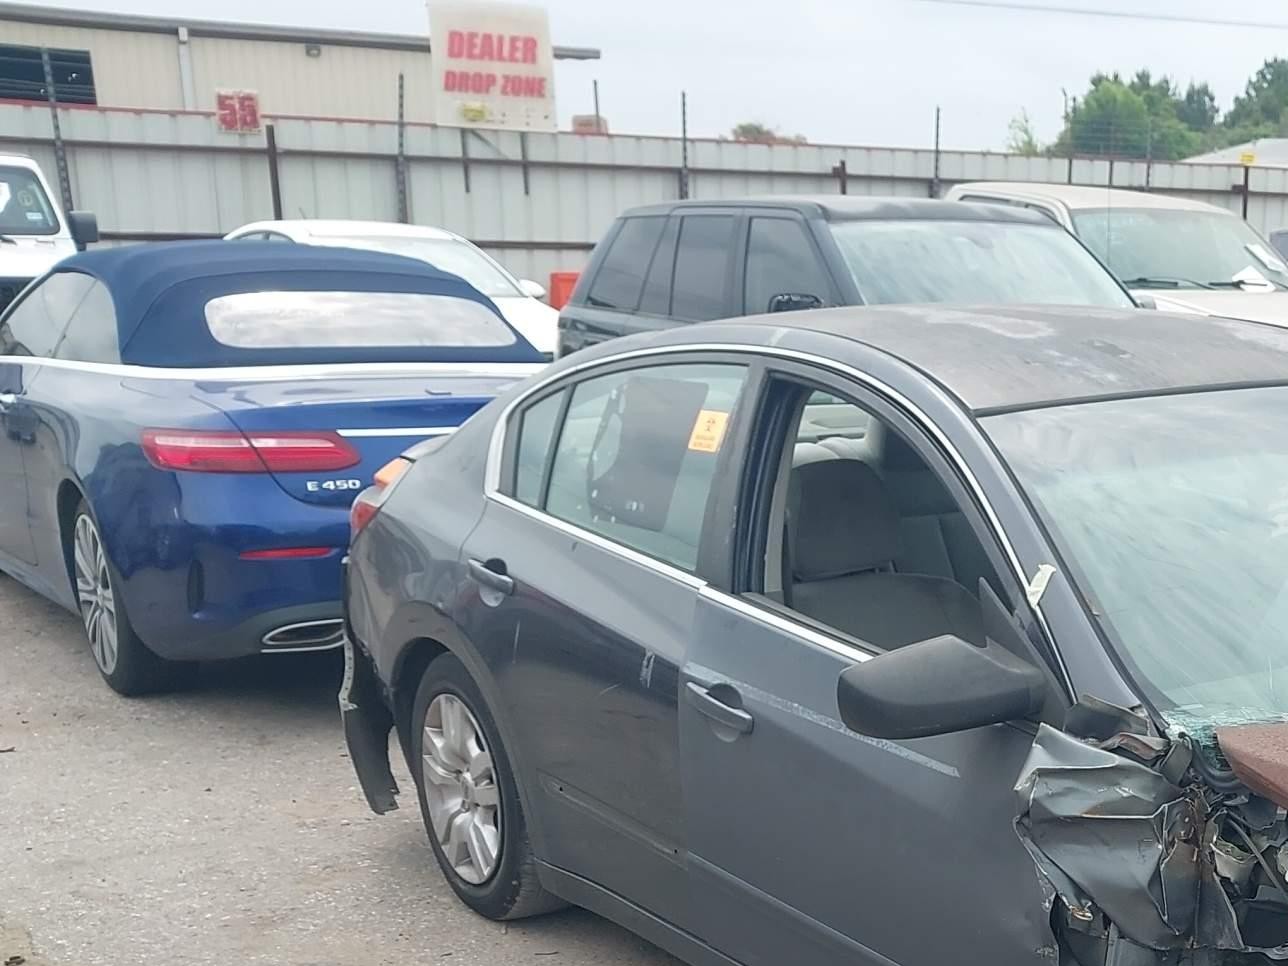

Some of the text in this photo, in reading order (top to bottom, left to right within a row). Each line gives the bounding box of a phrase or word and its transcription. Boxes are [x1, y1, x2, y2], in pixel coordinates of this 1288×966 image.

[447, 30, 537, 64] DEALER
[444, 70, 547, 98] DROP ZONE
[306, 479, 361, 491] E 450
